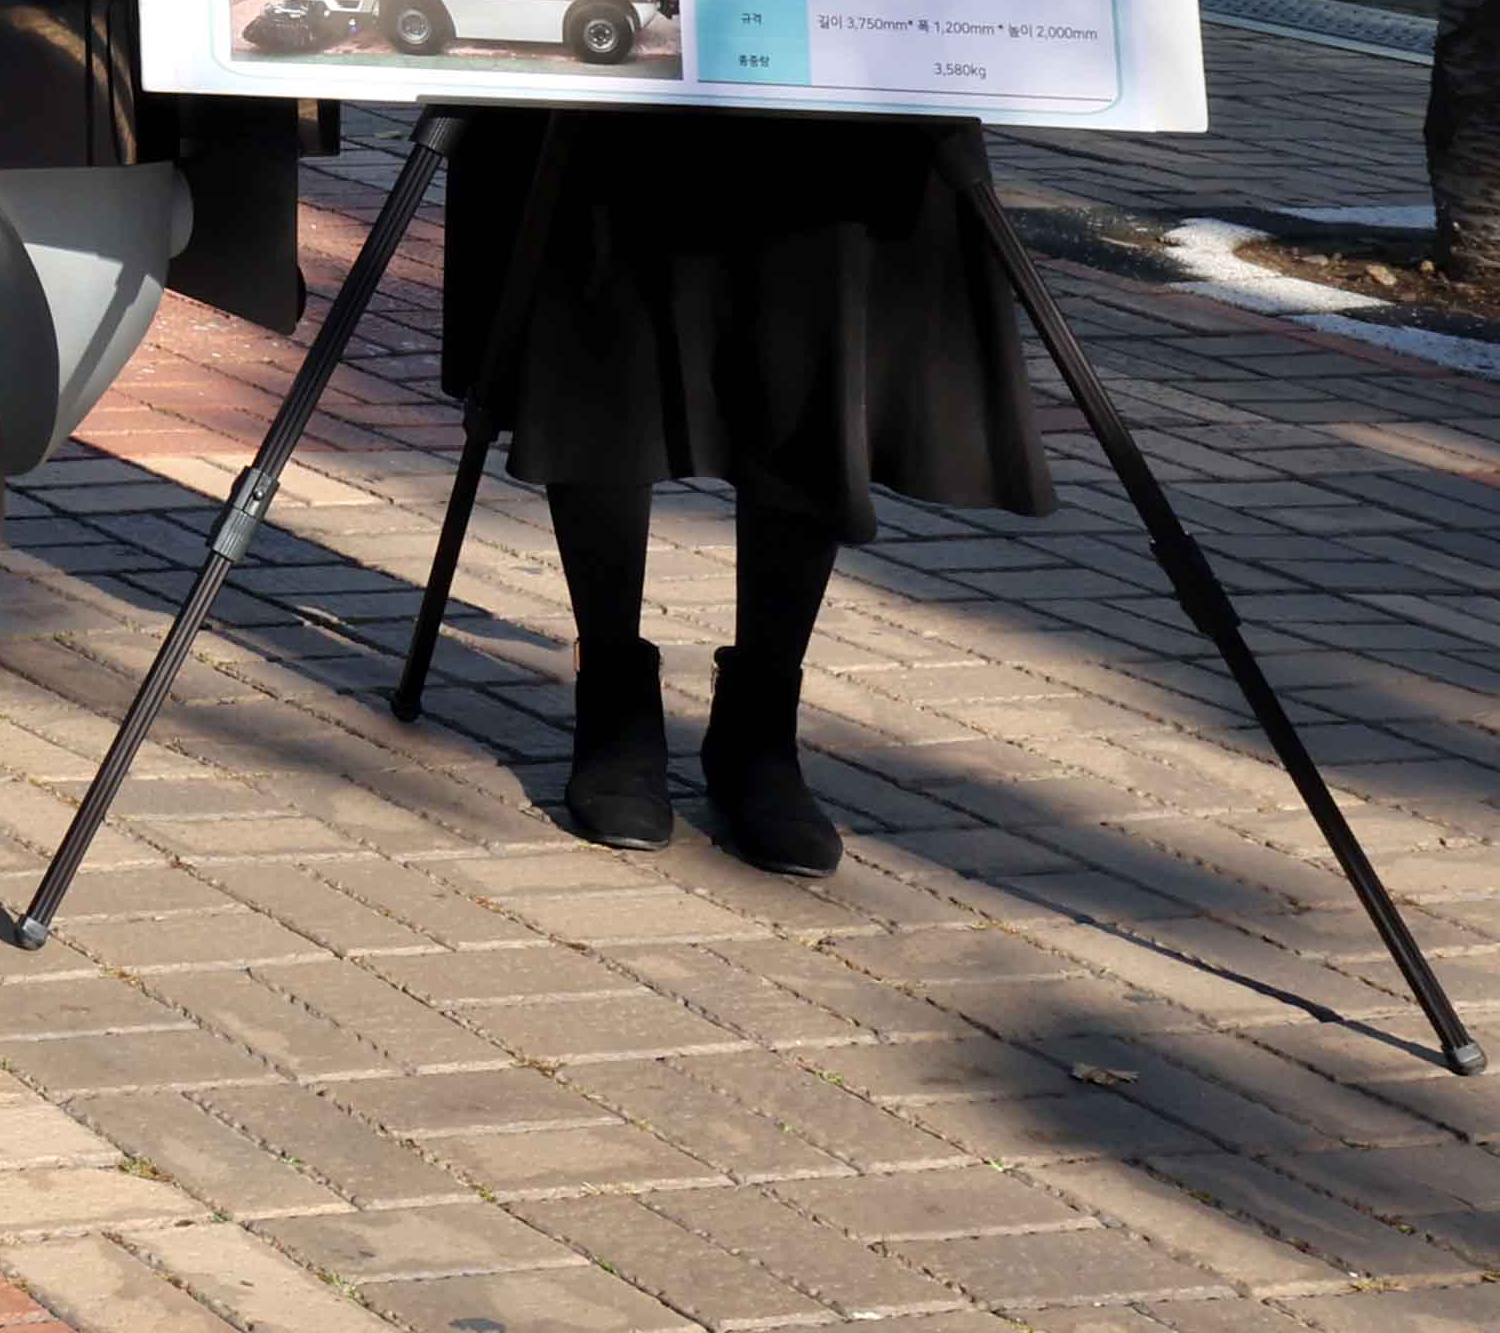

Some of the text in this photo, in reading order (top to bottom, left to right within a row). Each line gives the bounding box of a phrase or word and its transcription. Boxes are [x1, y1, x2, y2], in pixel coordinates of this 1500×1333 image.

[819, 14, 842, 30] 길이
[934, 20, 994, 35] 1,200mm
[1008, 24, 1033, 38] 높이
[1036, 25, 1098, 40] 2,000mm
[934, 63, 987, 79] 3,580kg
